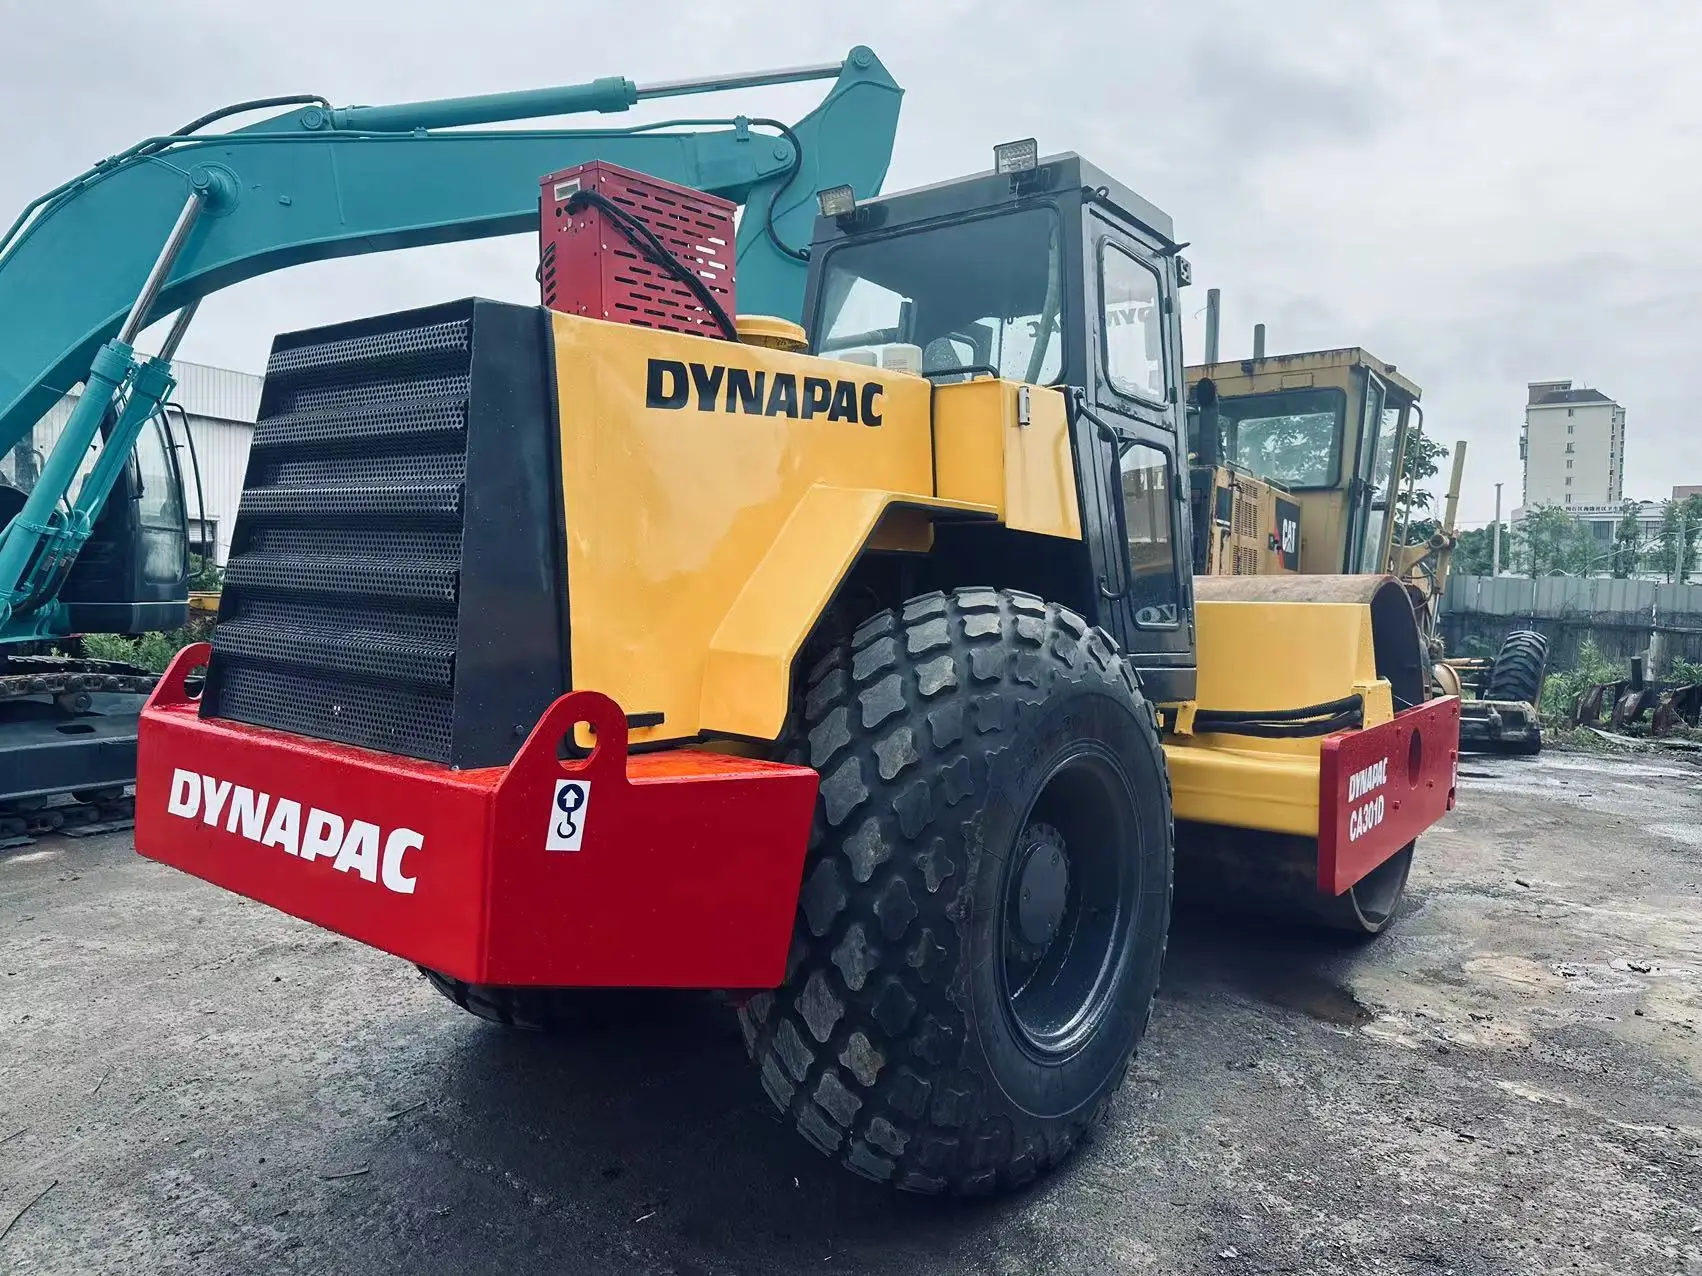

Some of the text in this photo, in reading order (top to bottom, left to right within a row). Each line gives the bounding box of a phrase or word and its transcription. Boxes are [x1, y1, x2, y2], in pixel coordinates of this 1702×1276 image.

[646, 358, 883, 427] DYNAPAC
[1282, 518, 1297, 554] CAT
[1348, 757, 1388, 803] DYNAPAC
[167, 768, 424, 894] DYNAPAC
[1349, 795, 1385, 842] CA301D
